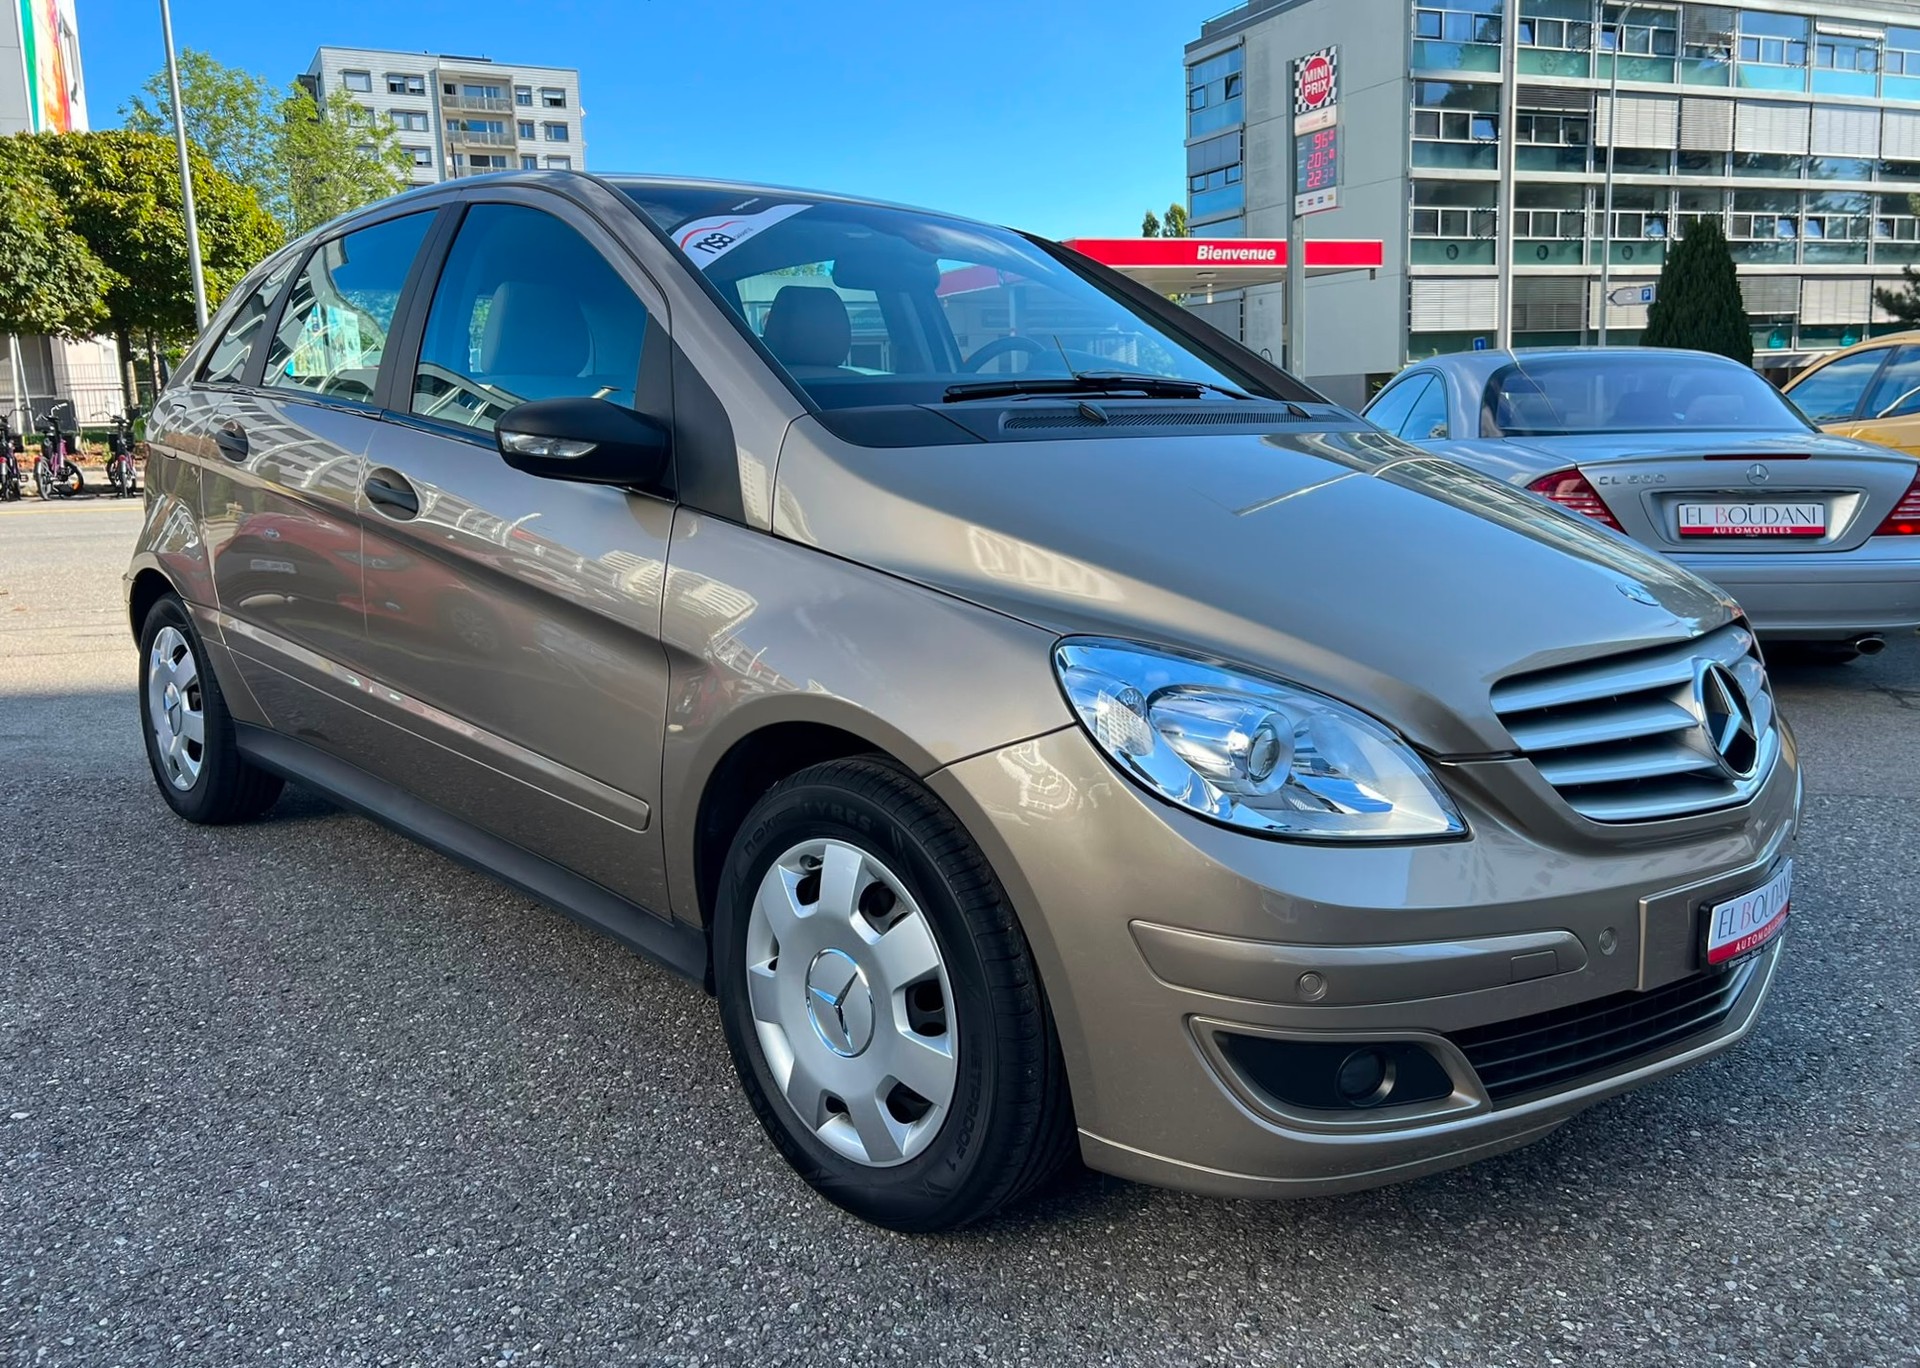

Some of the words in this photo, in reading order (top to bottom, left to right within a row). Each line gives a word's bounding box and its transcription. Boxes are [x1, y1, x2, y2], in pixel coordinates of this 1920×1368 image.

[1305, 64, 1328, 84] MINI
[1305, 78, 1328, 97] PRIX
[693, 232, 735, 254] nsa
[1196, 245, 1276, 260] Bienvenue
[1598, 476, 1621, 485] CL
[1686, 507, 1708, 525] EL
[1715, 506, 1816, 525] BOUDANI
[1717, 907, 1736, 939] EL
